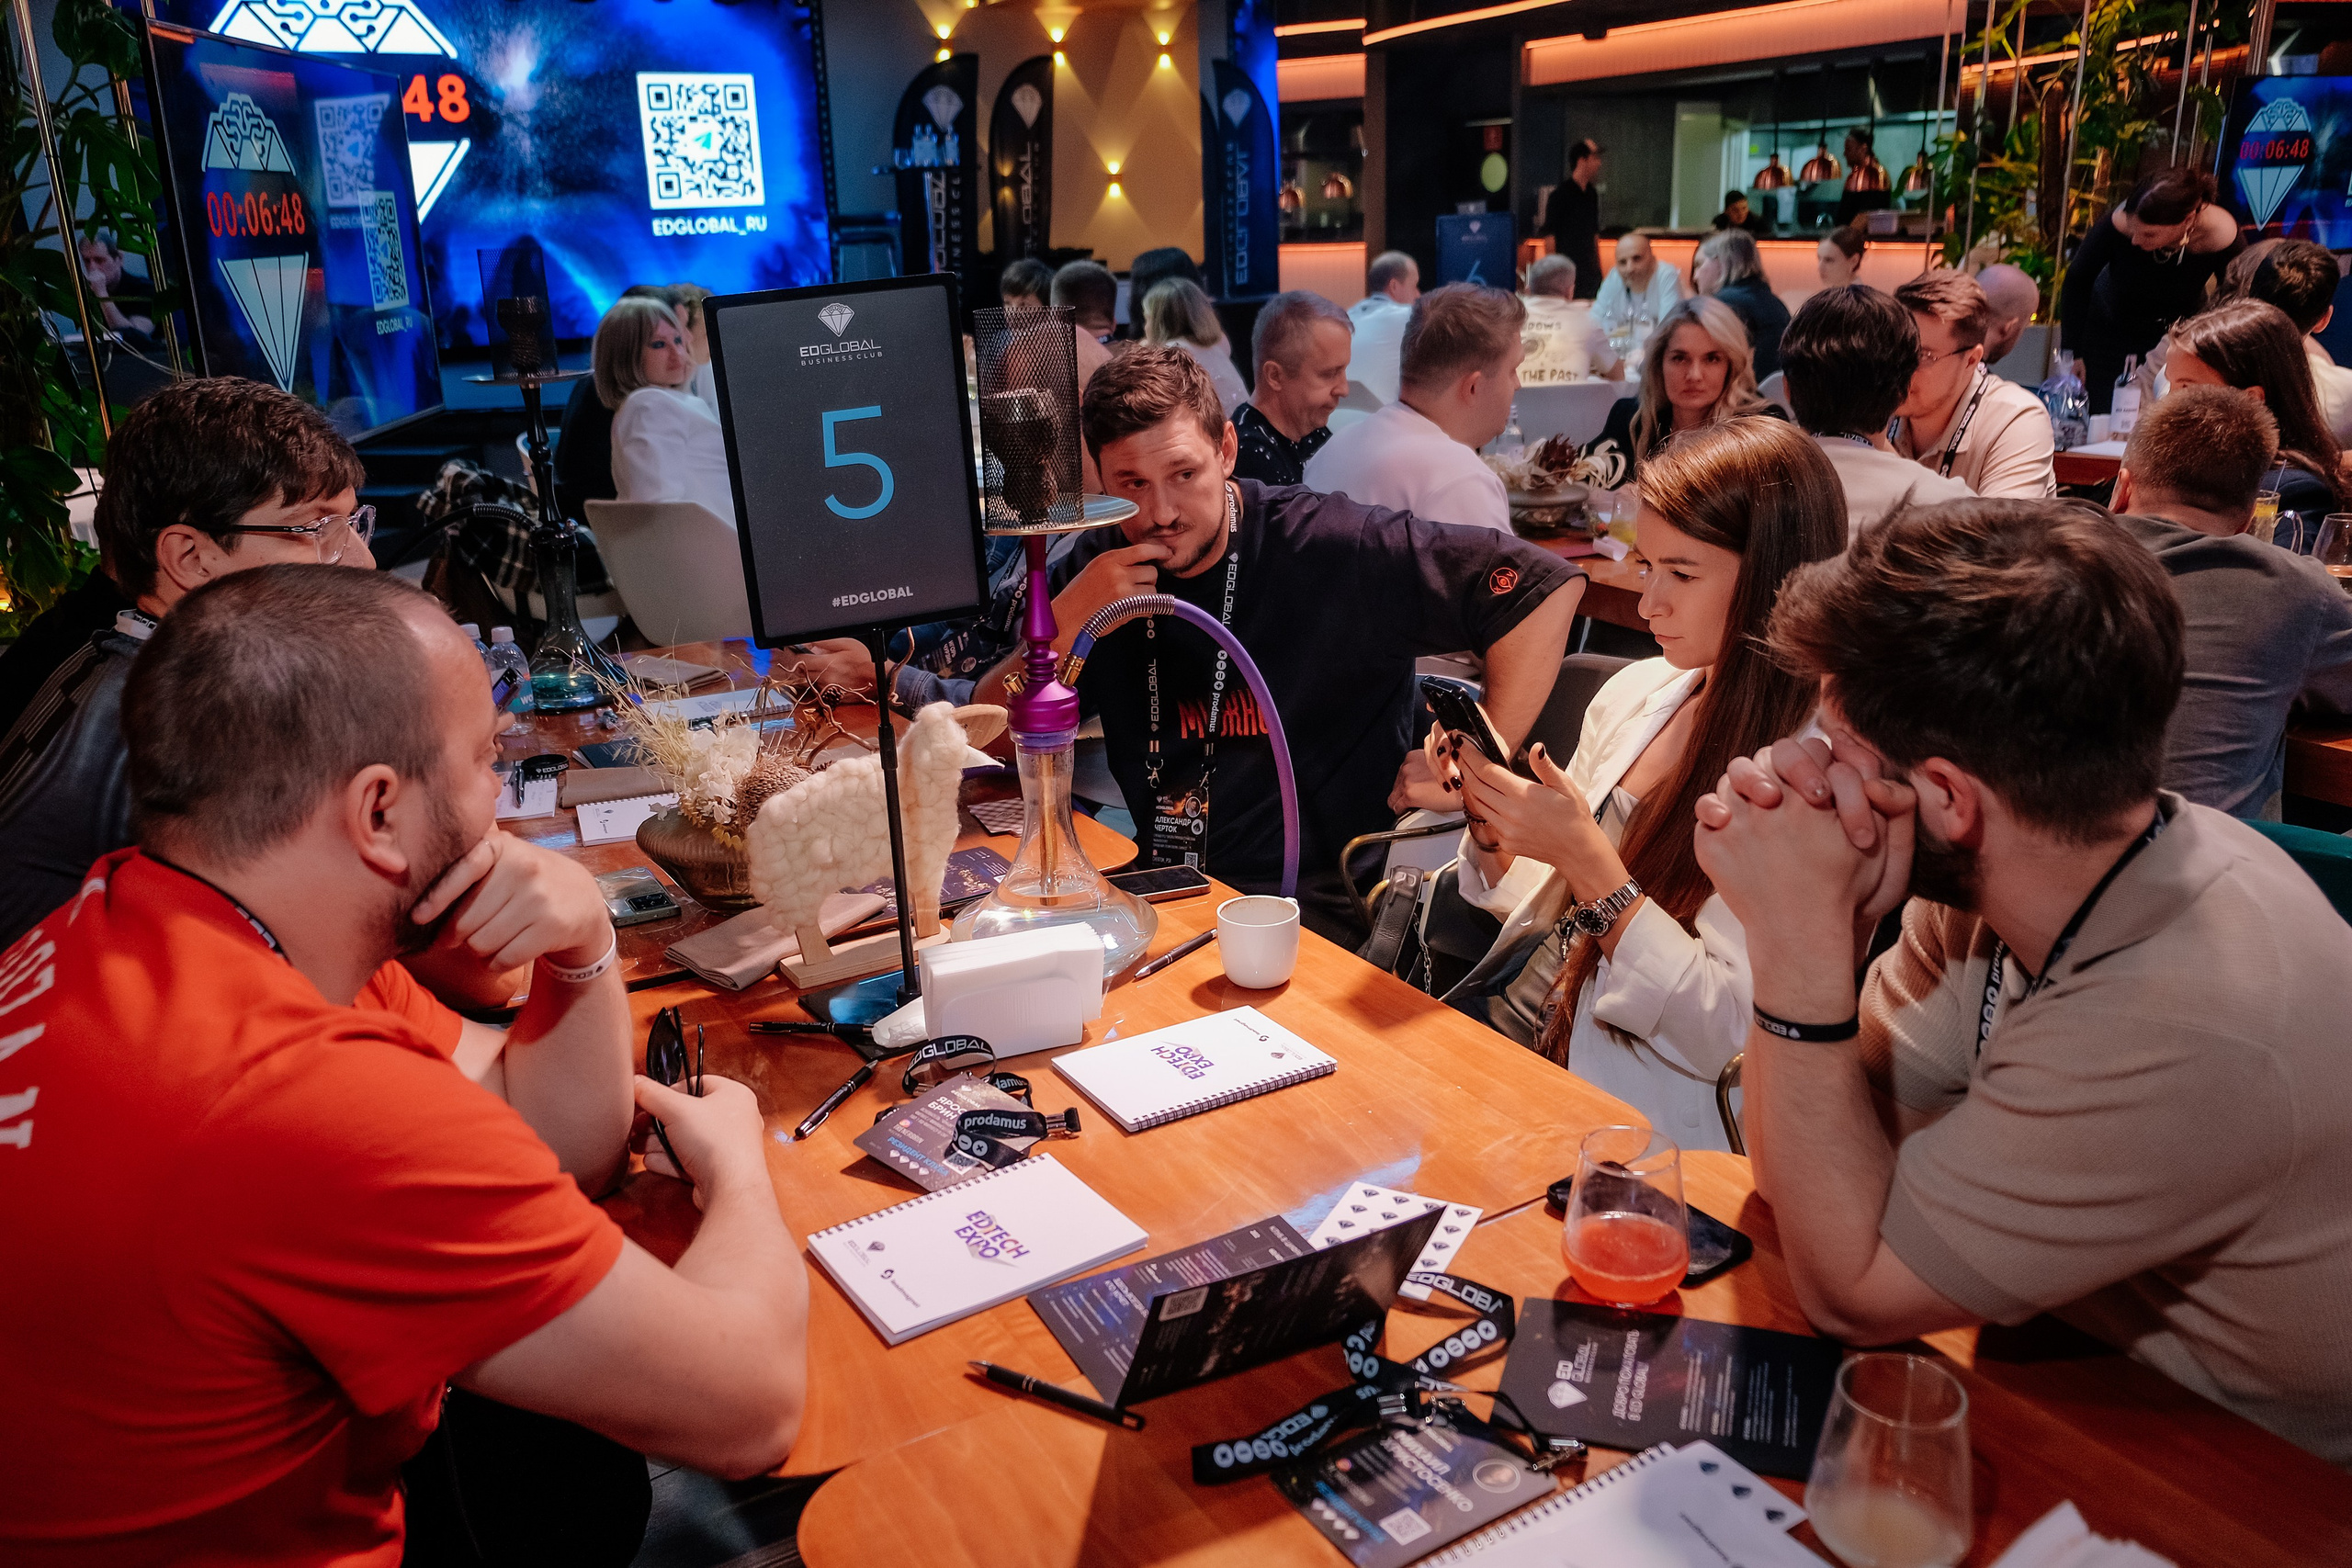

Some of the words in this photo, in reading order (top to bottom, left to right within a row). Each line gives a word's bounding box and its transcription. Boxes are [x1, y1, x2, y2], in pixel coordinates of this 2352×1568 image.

[2240, 139, 2311, 160] 00:06:48
[207, 191, 305, 238] 00:06:48
[651, 214, 768, 236] EDGLOBAL_RU
[799, 339, 882, 357] EDGLOBAL
[800, 355, 854, 367] BUSINESS
[856, 351, 883, 360] CLUB
[1521, 369, 1546, 382] THE
[1549, 368, 1578, 382] PAST
[821, 405, 895, 520] 5
[1227, 490, 1238, 533] prodamus
[831, 585, 914, 607] #EDGLOBAL
[1222, 563, 1238, 626] EDGLOBAL
[1148, 658, 1159, 722] EDGLOBAL
[1208, 692, 1221, 733] prodamus
[1154, 824, 1178, 833] ЧЕРТОК
[1155, 816, 1192, 827] АЛЕКСАНДР
[907, 1038, 992, 1070] EDGLOBAL
[1150, 1045, 1207, 1080] EDTECH
[1174, 1045, 1215, 1070] EXPO
[928, 1101, 957, 1121] БРИН
[966, 1112, 1027, 1132] prodamus
[887, 1136, 926, 1161] РЕЗИДЕНТ
[954, 1225, 1001, 1258] EXPO
[966, 1210, 1031, 1258] EDTECH
[1555, 1359, 1574, 1381] ED
[1611, 1383, 1630, 1420] ДОБРО
